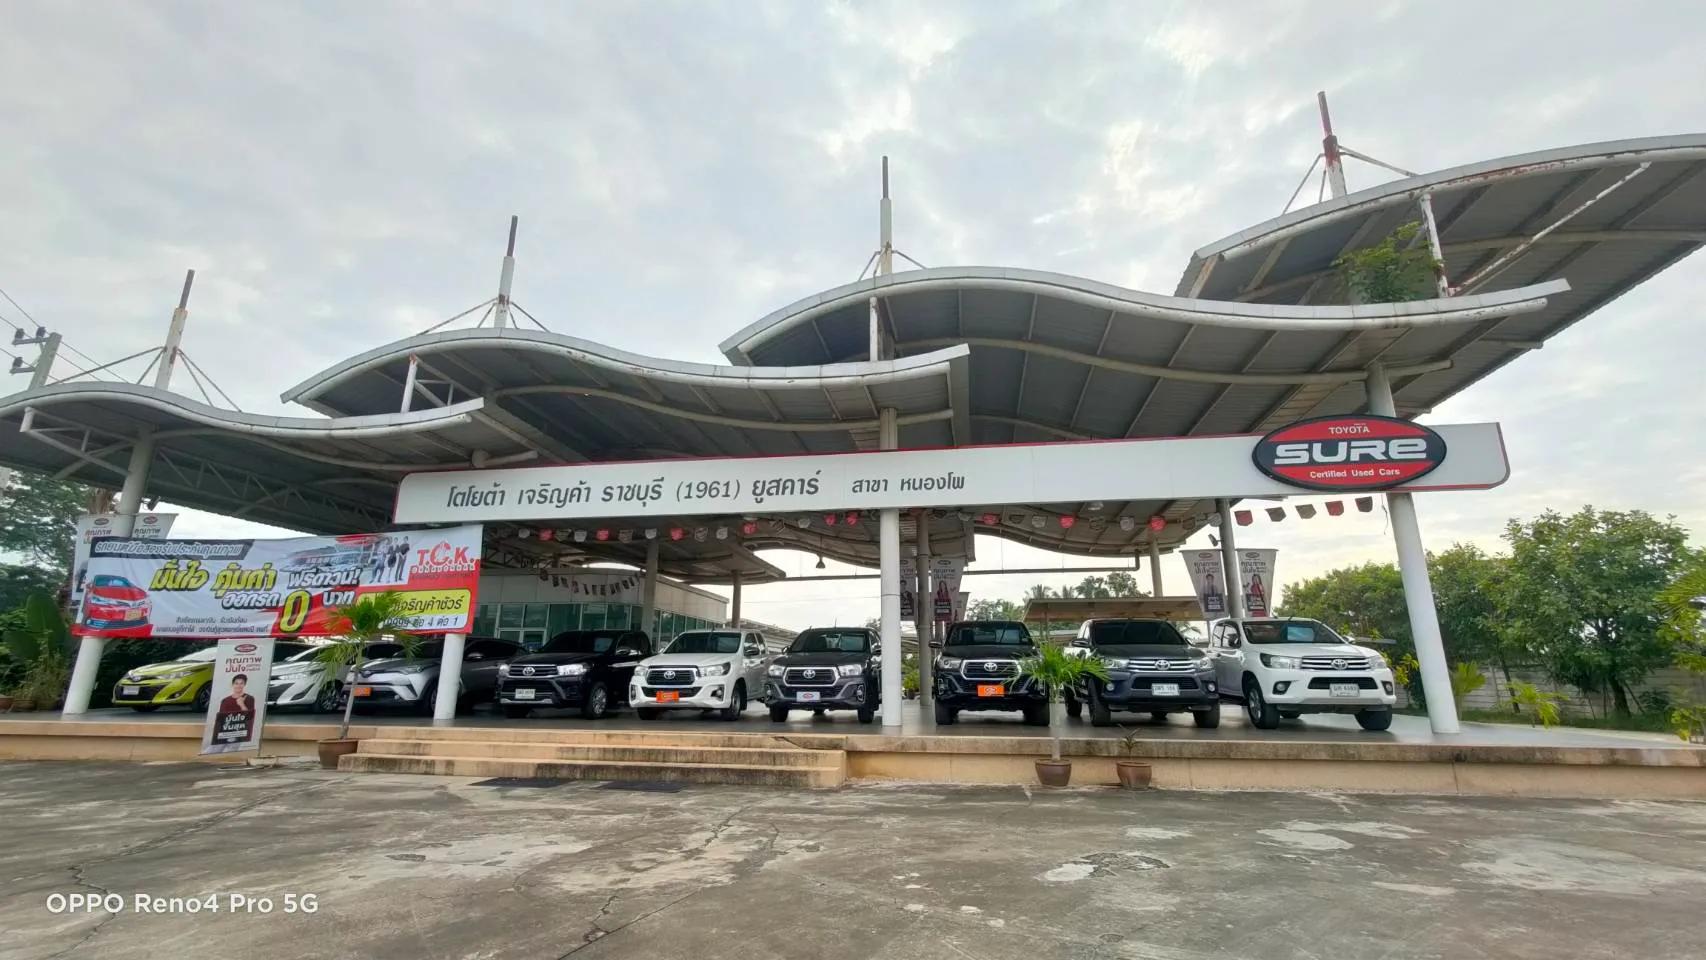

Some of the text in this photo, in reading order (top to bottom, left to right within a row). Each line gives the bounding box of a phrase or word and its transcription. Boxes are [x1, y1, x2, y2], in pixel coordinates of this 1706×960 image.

[1328, 426, 1371, 434] TOYOTA
[447, 470, 965, 508] โตโยต้า เจริญค้า ราชบุรี (1961) ยูสคาร์ สาขา หนองโพ
[1310, 467, 1401, 479] Certified Used Cars
[150, 559, 209, 591] มั่นใจ
[211, 562, 277, 598] คุ้มค่า
[280, 588, 311, 633] 0
[323, 589, 355, 606] บาท
